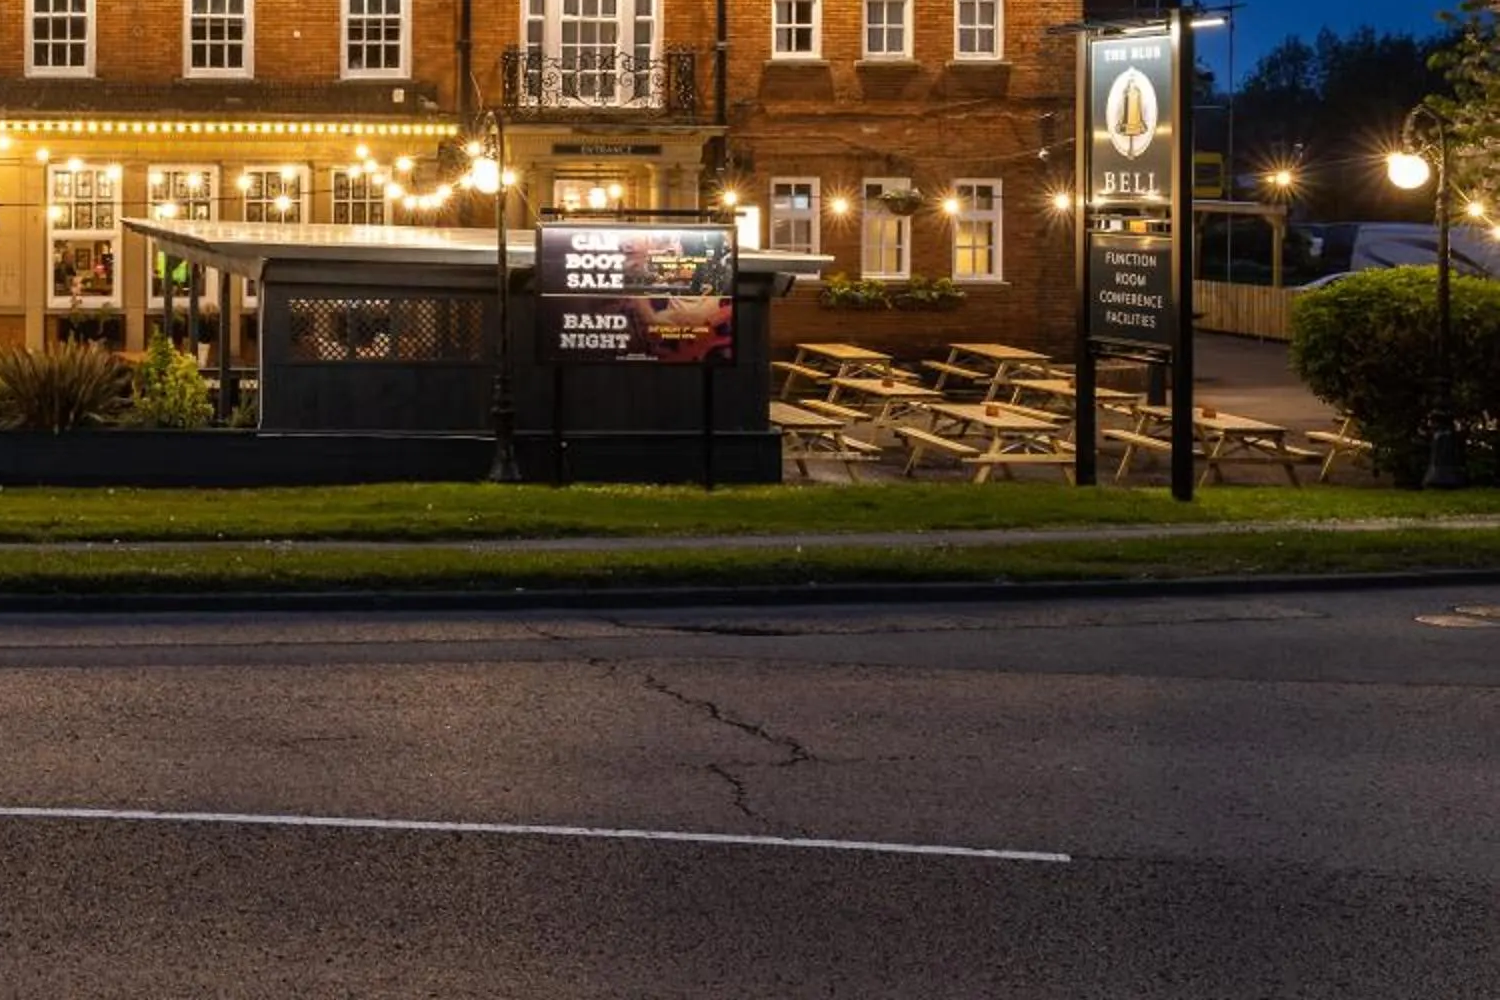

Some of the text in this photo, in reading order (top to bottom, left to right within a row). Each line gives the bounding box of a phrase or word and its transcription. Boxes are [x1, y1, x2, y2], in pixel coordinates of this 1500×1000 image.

[581, 145, 632, 154] ENTRANCE
[1104, 171, 1160, 193] BELL
[566, 254, 626, 269] BOOT
[1105, 252, 1157, 266] FUNCTION
[567, 273, 623, 288] SALE
[1115, 272, 1147, 286] ROOM
[1100, 290, 1163, 308] CONFERENCE
[563, 314, 628, 329] BAND
[1105, 311, 1156, 328] FACILITIES
[560, 333, 631, 349] NIGHT
